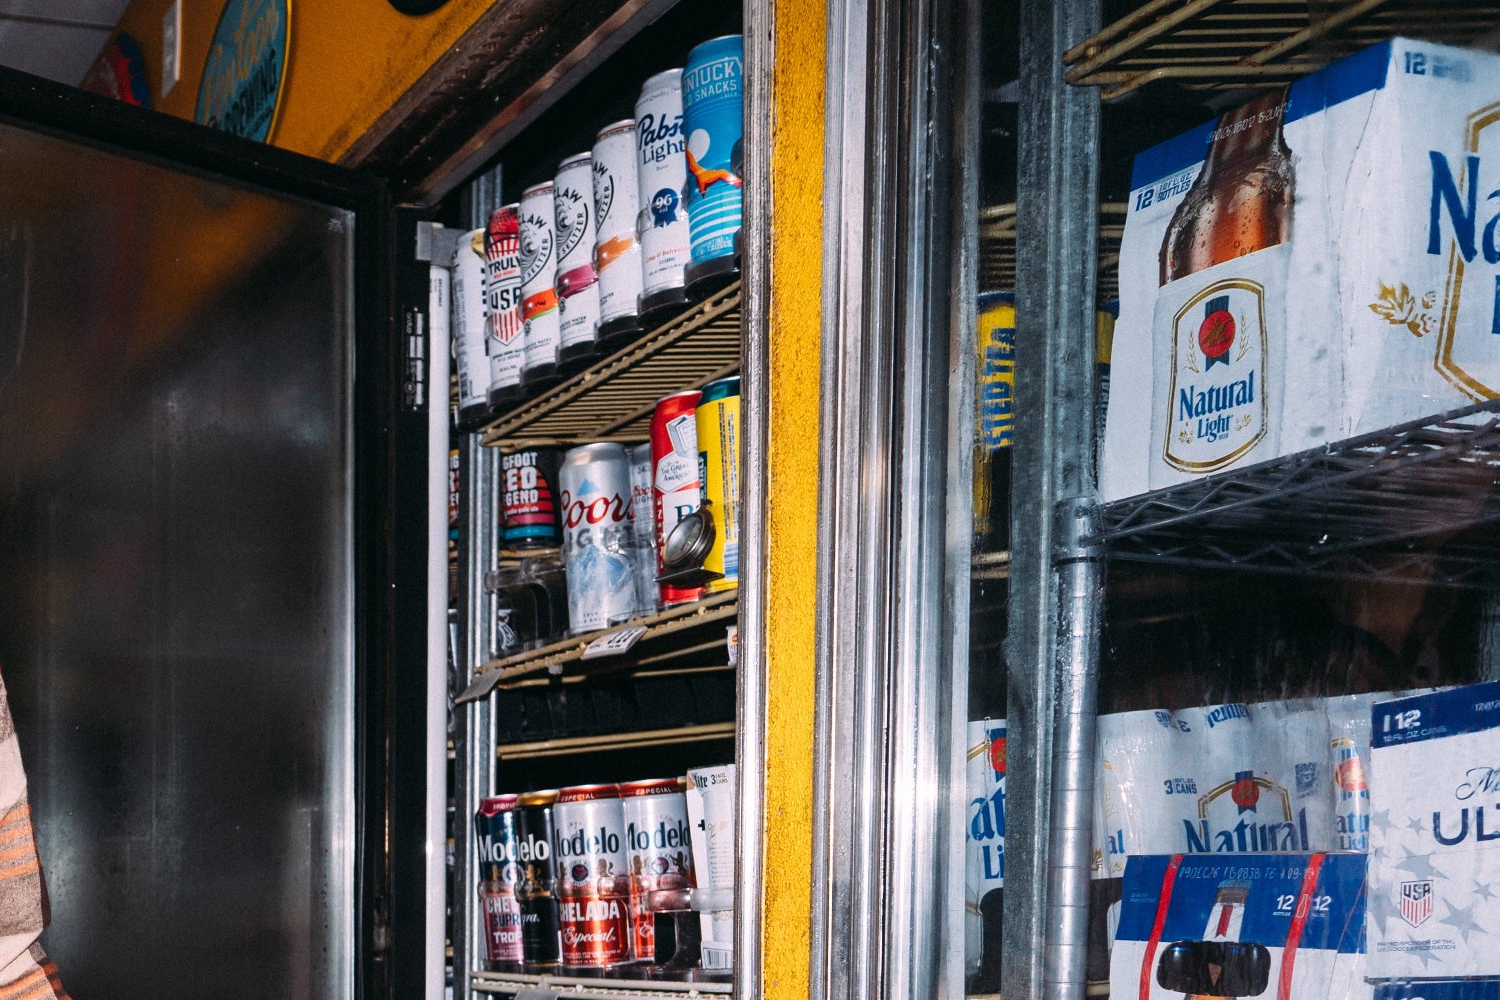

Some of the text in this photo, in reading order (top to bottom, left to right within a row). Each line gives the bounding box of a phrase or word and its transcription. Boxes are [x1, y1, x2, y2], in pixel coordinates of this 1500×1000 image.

[1404, 52, 1426, 75] 12
[695, 80, 737, 101] SNACKS
[643, 139, 685, 165] Light
[655, 194, 674, 210] 96
[1135, 180, 1192, 212] 12 BOTTLES
[561, 211, 585, 254] SELTZER
[488, 256, 521, 275] TRULY
[527, 238, 549, 277] SELTZER
[1180, 369, 1254, 421] Natural
[1197, 414, 1232, 443] Light
[1395, 709, 1421, 730] 12
[561, 793, 596, 802] ESPECIAL
[635, 787, 673, 796] ESPECIAL
[1164, 779, 1197, 795] 3 CANS
[1182, 806, 1310, 852] Natural
[1403, 883, 1431, 900] USA
[1276, 895, 1332, 911] 12 12
